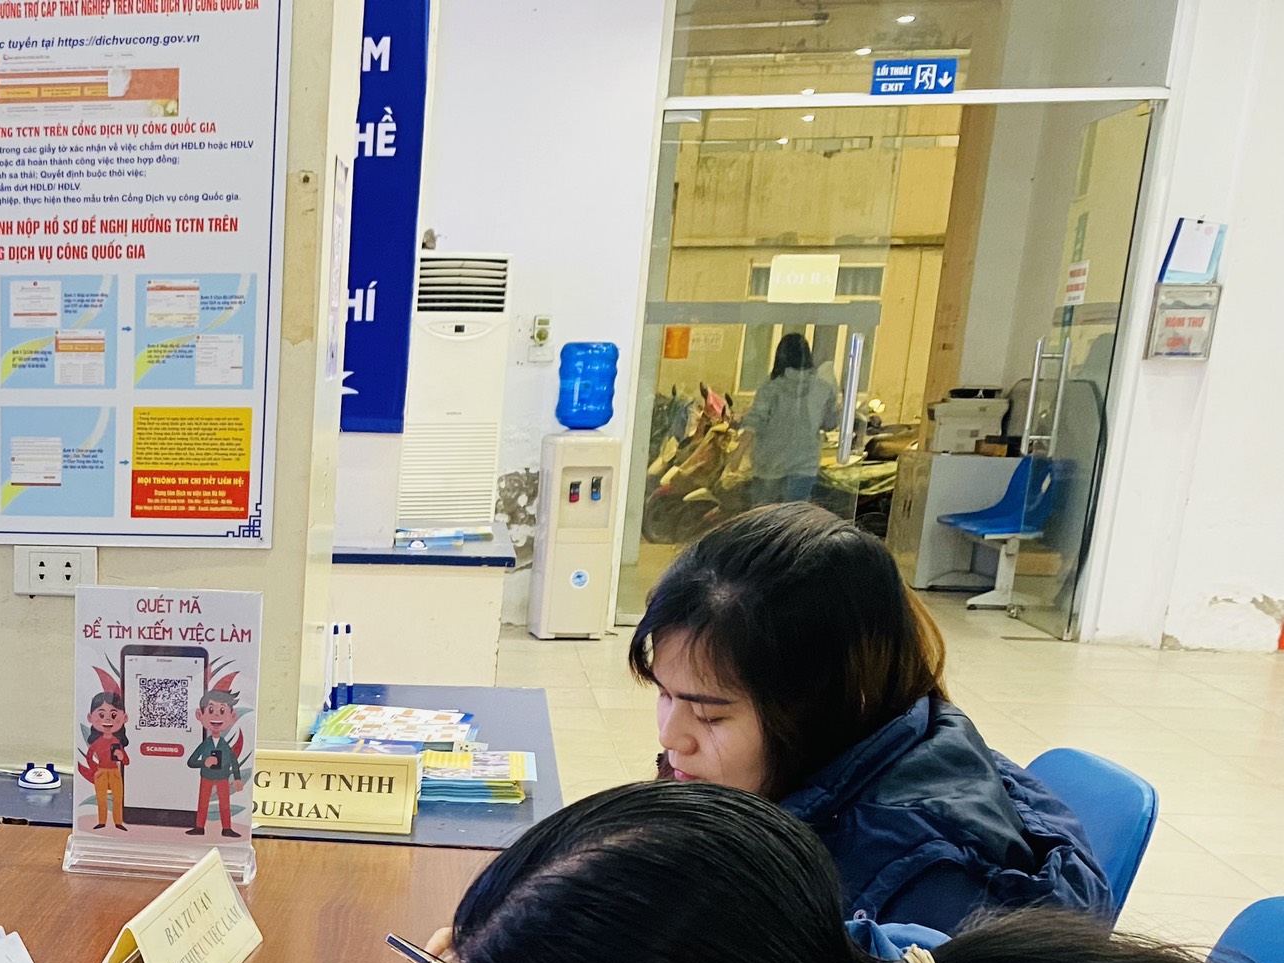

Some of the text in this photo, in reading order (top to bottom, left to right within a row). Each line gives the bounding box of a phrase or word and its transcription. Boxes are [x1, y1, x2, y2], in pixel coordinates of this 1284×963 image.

[8, 36, 38, 51] tuyến
[41, 37, 54, 50] tại
[57, 34, 200, 49] https://dichvucong.gov.vn
[876, 64, 913, 77] LỐI THOÁT
[880, 82, 905, 93] EXIT
[16, 217, 41, 239] NỘP
[43, 214, 59, 236] HỒ
[62, 217, 78, 235] SƠ
[81, 214, 97, 235] ĐỀ
[100, 218, 128, 237] NGHỊ
[131, 213, 171, 234] HƯỞNG
[175, 217, 205, 234] TCTN
[207, 214, 239, 233] TRÊN
[8, 245, 35, 263] DỊCH
[38, 245, 53, 264] VỤ
[56, 242, 88, 260] CÔNG
[91, 239, 123, 261] QUỐC
[126, 244, 146, 260] GIA
[136, 594, 202, 614] QUÉT MÃ
[82, 616, 252, 645] ĐỂ TÌM KIẾM VIỆC LÀM
[279, 770, 315, 791] TY
[320, 773, 395, 795] TNHH
